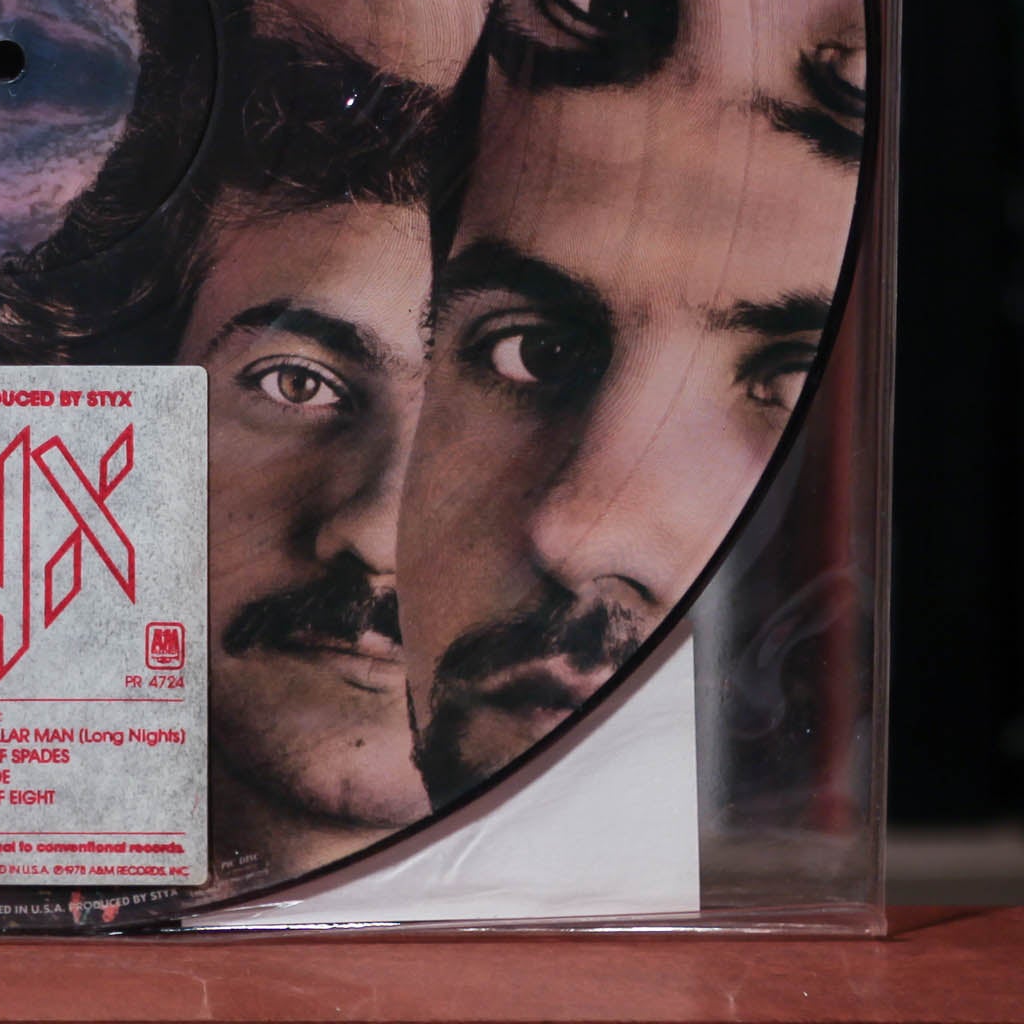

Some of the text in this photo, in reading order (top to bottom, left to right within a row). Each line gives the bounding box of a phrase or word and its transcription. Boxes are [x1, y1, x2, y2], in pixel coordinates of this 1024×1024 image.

[59, 390, 83, 407] BY
[87, 390, 133, 407] STYX
[125, 675, 185, 689] PR 4724
[34, 728, 74, 743] MAN
[79, 728, 125, 747] (Long
[129, 728, 186, 747] Nights)
[12, 748, 70, 764] SPADES
[9, 790, 56, 805] EIGHT
[19, 841, 33, 853] to
[36, 841, 126, 854] conventional
[129, 841, 185, 854] records.
[9, 865, 20, 874] IN
[89, 865, 115, 875] A&M
[15, 905, 28, 914] IN
[31, 905, 66, 915] U.S.A.
[69, 897, 130, 912] PRODUCED
[133, 894, 148, 905] BY
